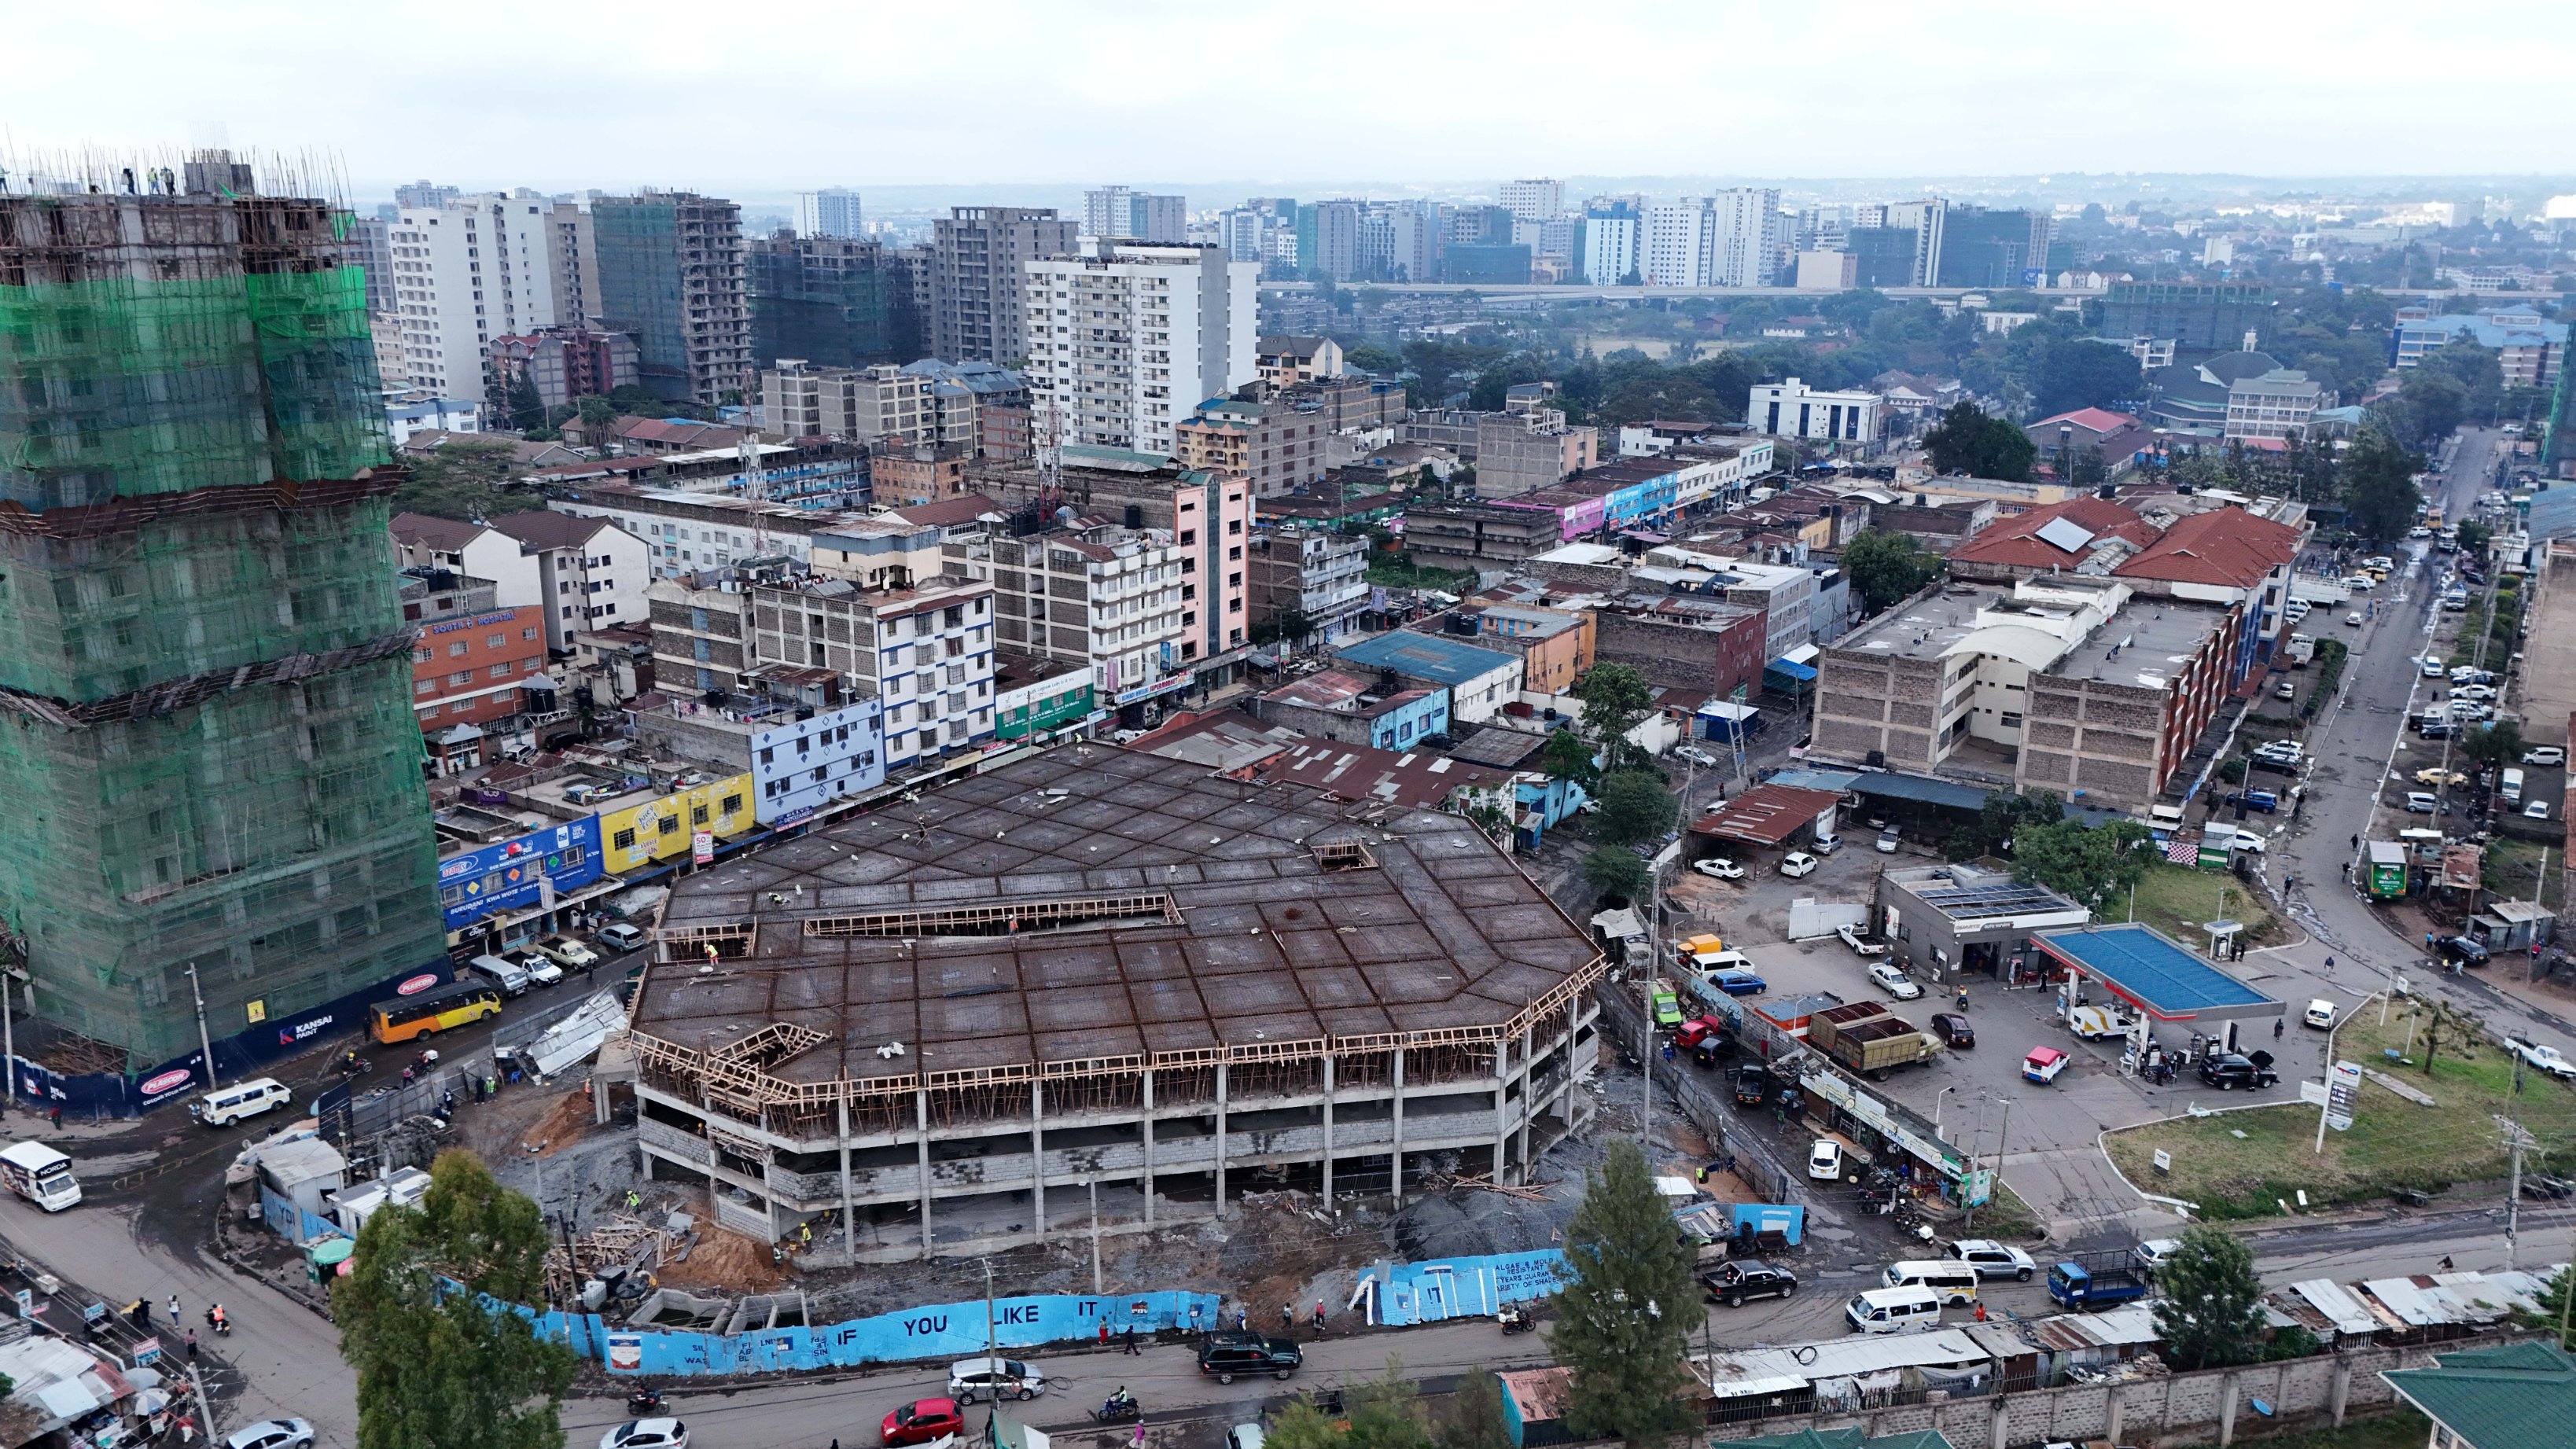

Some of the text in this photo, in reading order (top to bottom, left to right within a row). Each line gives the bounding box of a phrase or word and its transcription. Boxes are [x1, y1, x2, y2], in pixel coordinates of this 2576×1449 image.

[433, 621, 464, 634] SOUTH
[477, 612, 516, 626] HOSPITAL
[451, 899, 484, 914] BURUDANI
[486, 895, 500, 903] KWA
[502, 888, 518, 898] WOTE
[403, 976, 434, 992] PLASCON
[296, 1015, 332, 1033] KANSAI
[296, 1028, 317, 1040] PAINT
[148, 1072, 185, 1091] PLASCON
[143, 1082, 196, 1105] COLOUR YOUR WORLD
[40, 1163, 68, 1176] NORDA
[1495, 1262, 1521, 1271] ALGAE
[1507, 1264, 1544, 1274] RESISTANT
[1500, 1274, 1522, 1283] YEARS
[1496, 1282, 1519, 1292] ARIETY
[837, 1329, 857, 1345] IF
[903, 1315, 948, 1336] YOU
[1078, 1301, 1098, 1316] IT
